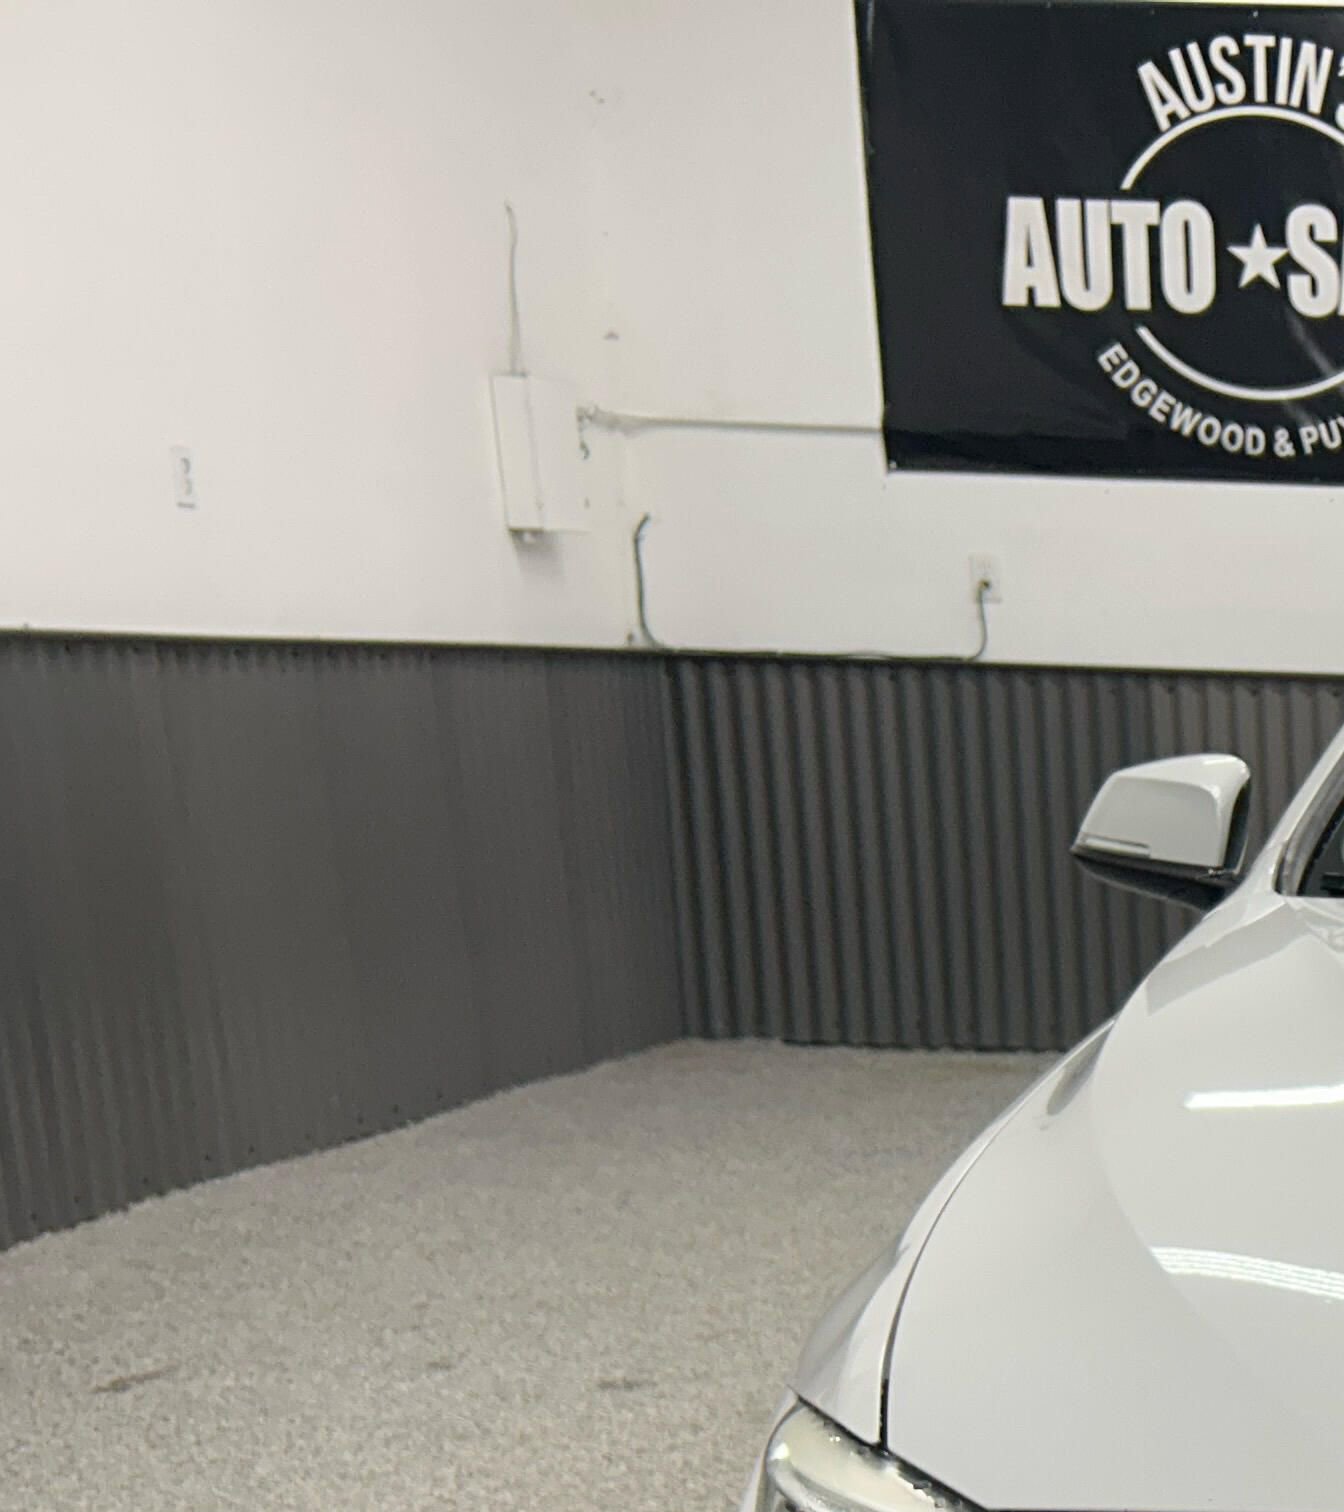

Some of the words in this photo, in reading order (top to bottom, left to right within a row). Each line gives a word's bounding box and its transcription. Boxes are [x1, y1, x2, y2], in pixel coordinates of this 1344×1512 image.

[1002, 195, 1216, 315] AUTO
[1097, 341, 1265, 458] EDGEWOOD
[1273, 427, 1296, 459] &
